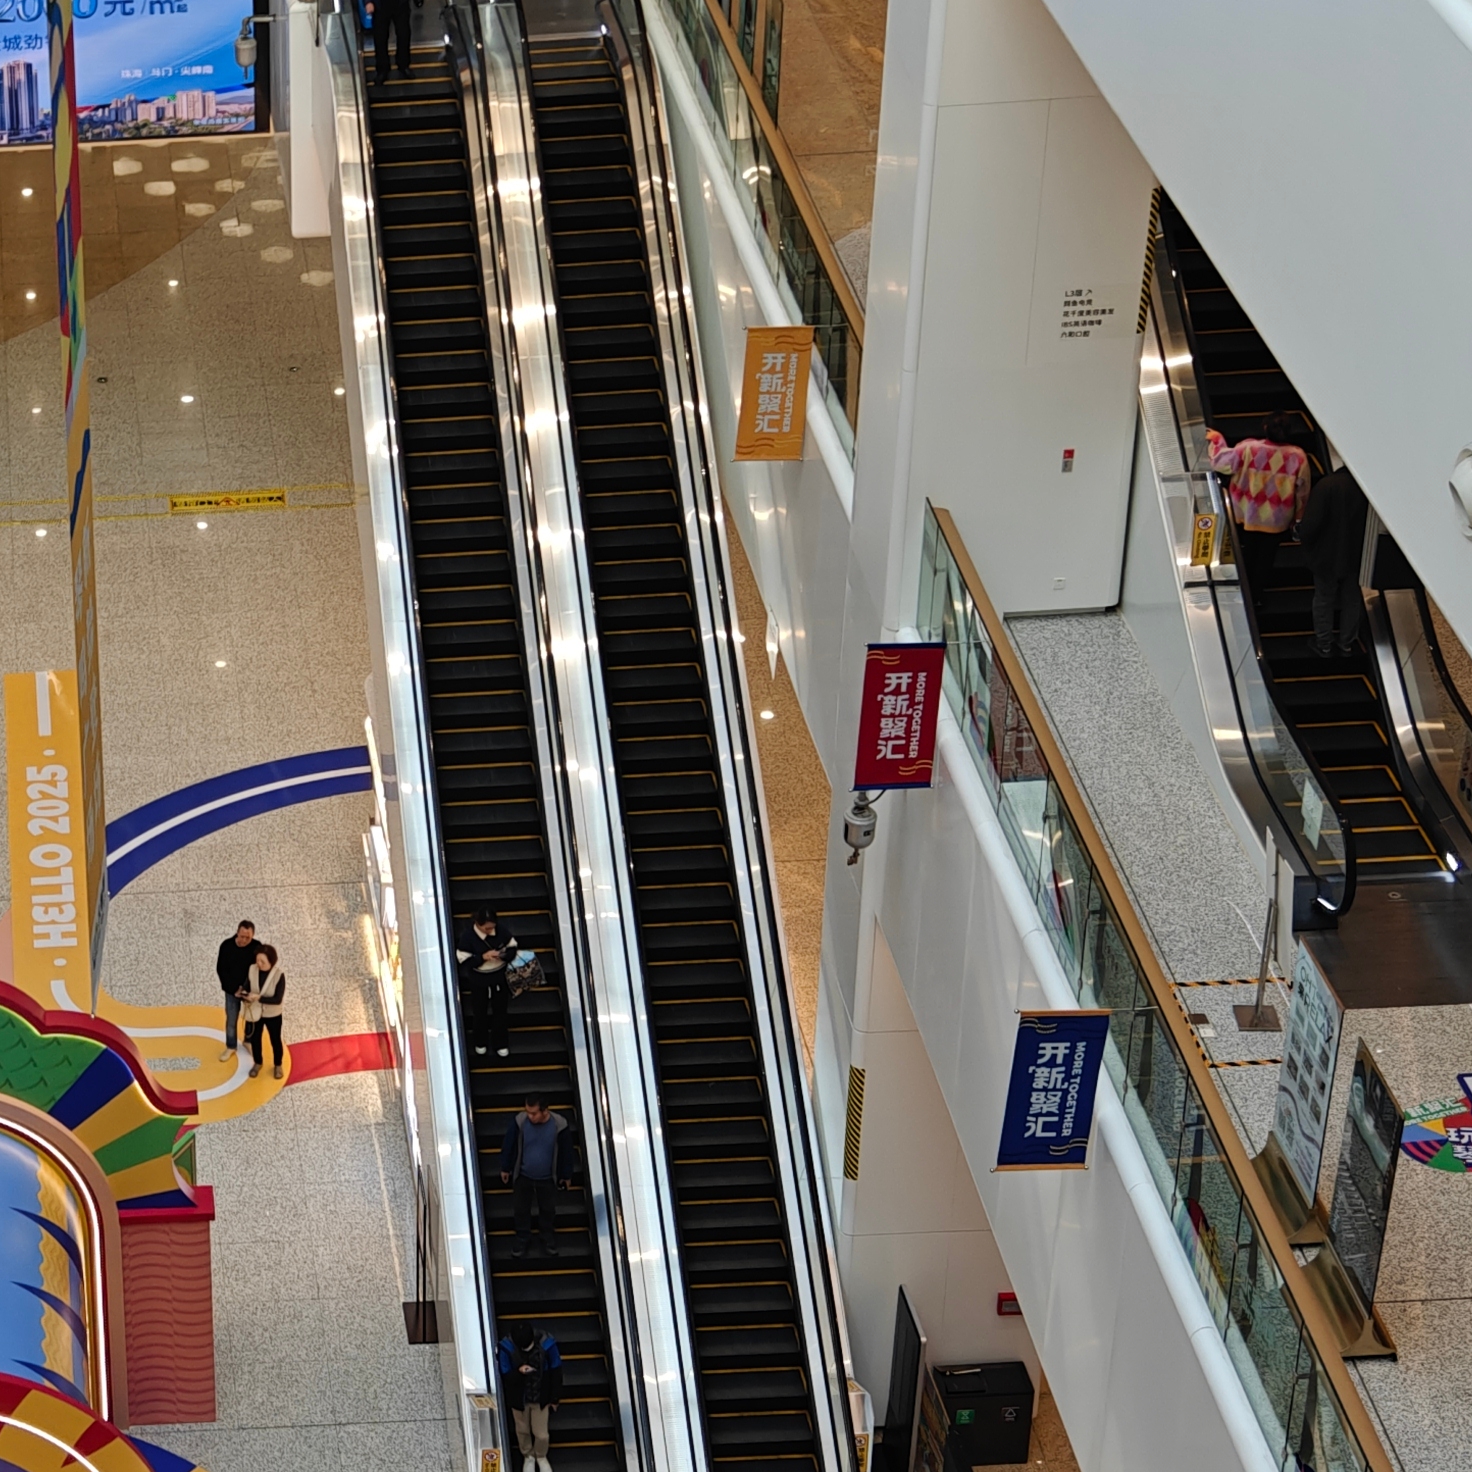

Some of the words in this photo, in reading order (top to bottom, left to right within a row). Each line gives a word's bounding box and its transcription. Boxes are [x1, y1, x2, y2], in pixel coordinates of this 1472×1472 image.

[914, 671, 927, 703] MORE
[908, 704, 923, 759] TOGETHER
[26, 764, 71, 837] 2025
[28, 843, 78, 949] HELLO
[1071, 1041, 1087, 1076] MORE
[1061, 1076, 1081, 1137] TOGETHER
